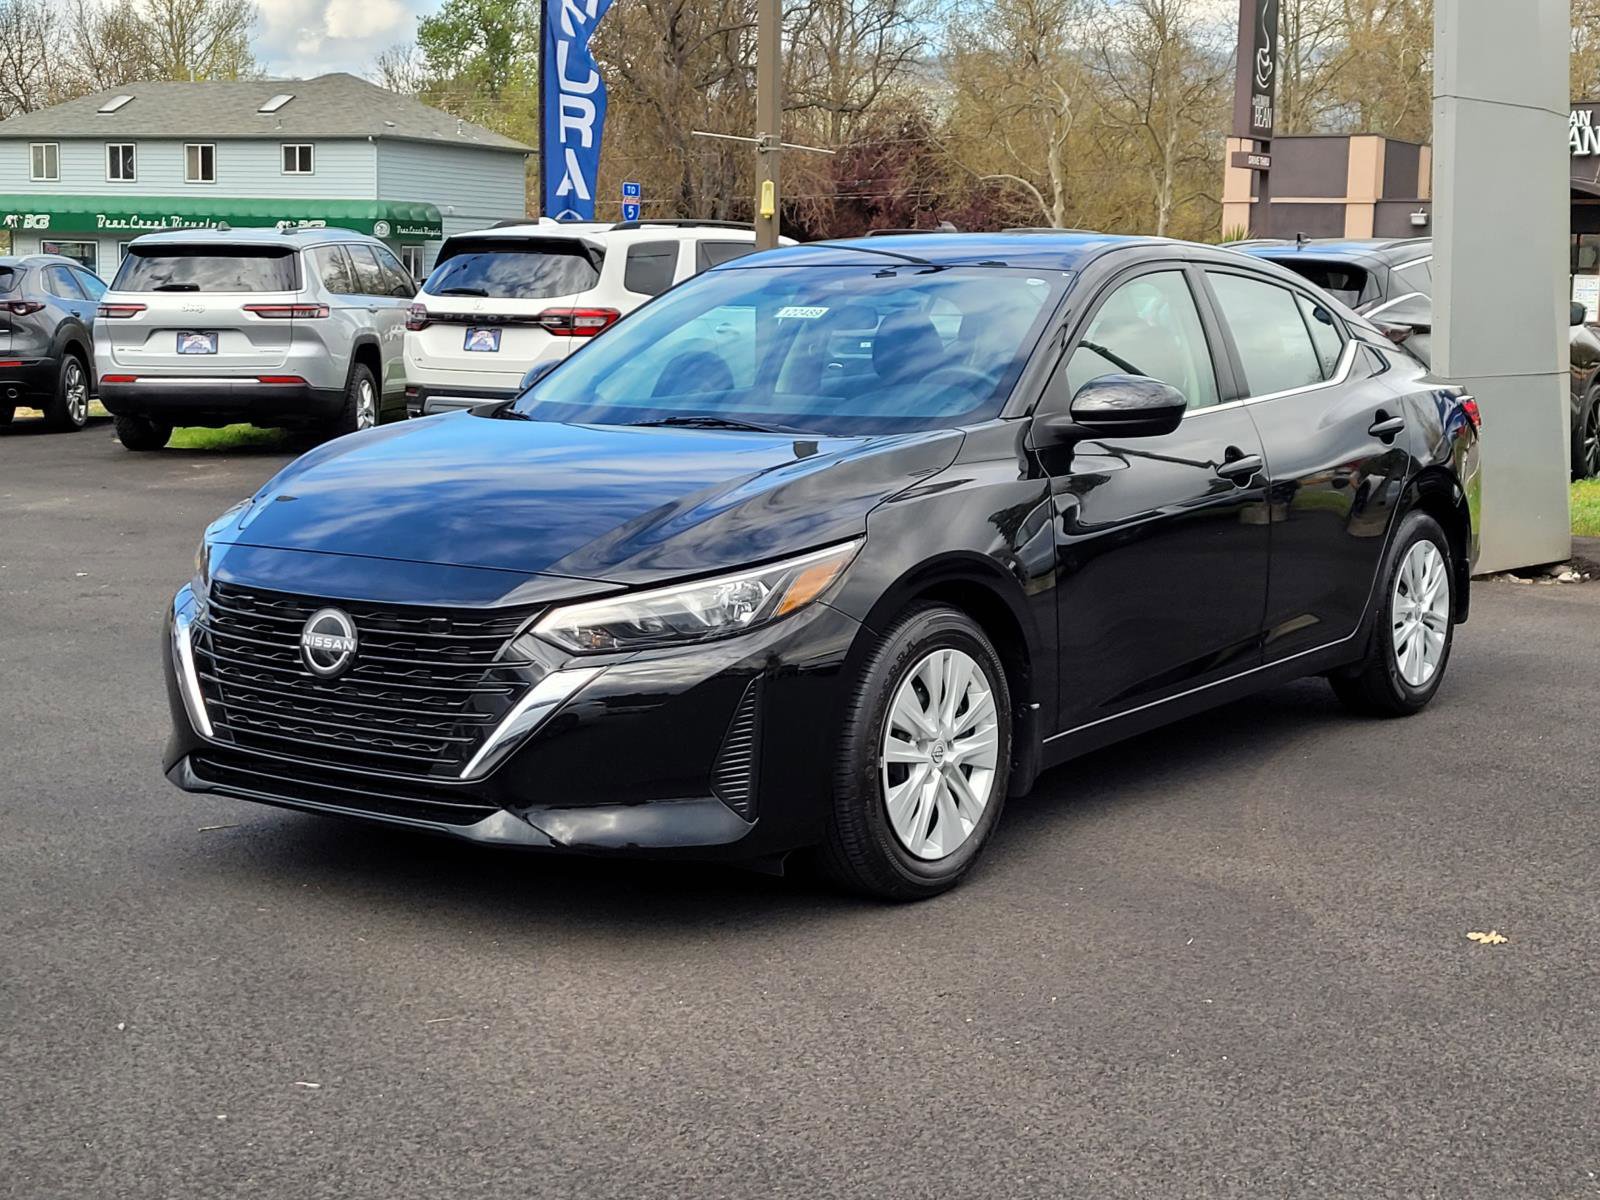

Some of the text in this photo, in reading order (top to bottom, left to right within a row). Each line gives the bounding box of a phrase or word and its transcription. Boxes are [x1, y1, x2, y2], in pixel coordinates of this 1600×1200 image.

[1254, 106, 1272, 129] BEAN
[626, 186, 636, 195] TO
[628, 205, 635, 219] 5
[96, 214, 129, 229] Bear
[130, 215, 168, 229] Creek
[444, 313, 515, 322] PILOT
[302, 633, 355, 651] NISSAN
